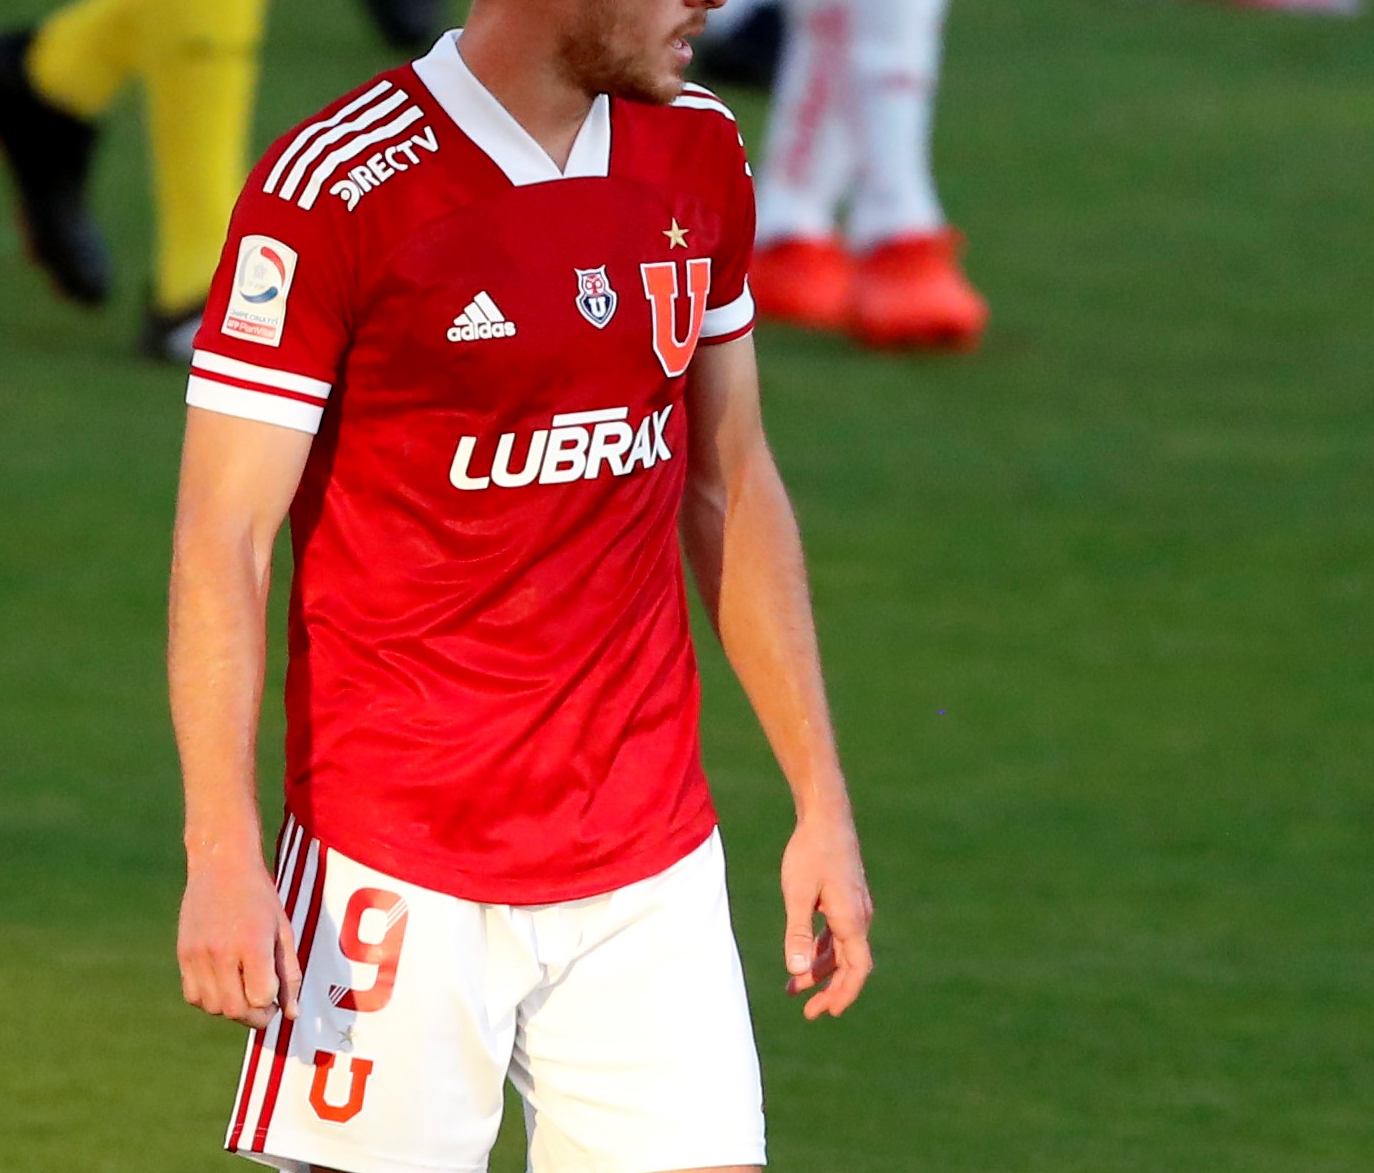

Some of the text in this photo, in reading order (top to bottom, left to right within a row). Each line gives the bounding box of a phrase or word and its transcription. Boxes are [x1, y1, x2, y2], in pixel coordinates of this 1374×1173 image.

[447, 321, 516, 342] adidas
[589, 297, 610, 317] U
[640, 258, 711, 377] U
[449, 404, 673, 490] LUBRAX
[328, 886, 408, 1012] 9
[309, 1049, 373, 1123] U
